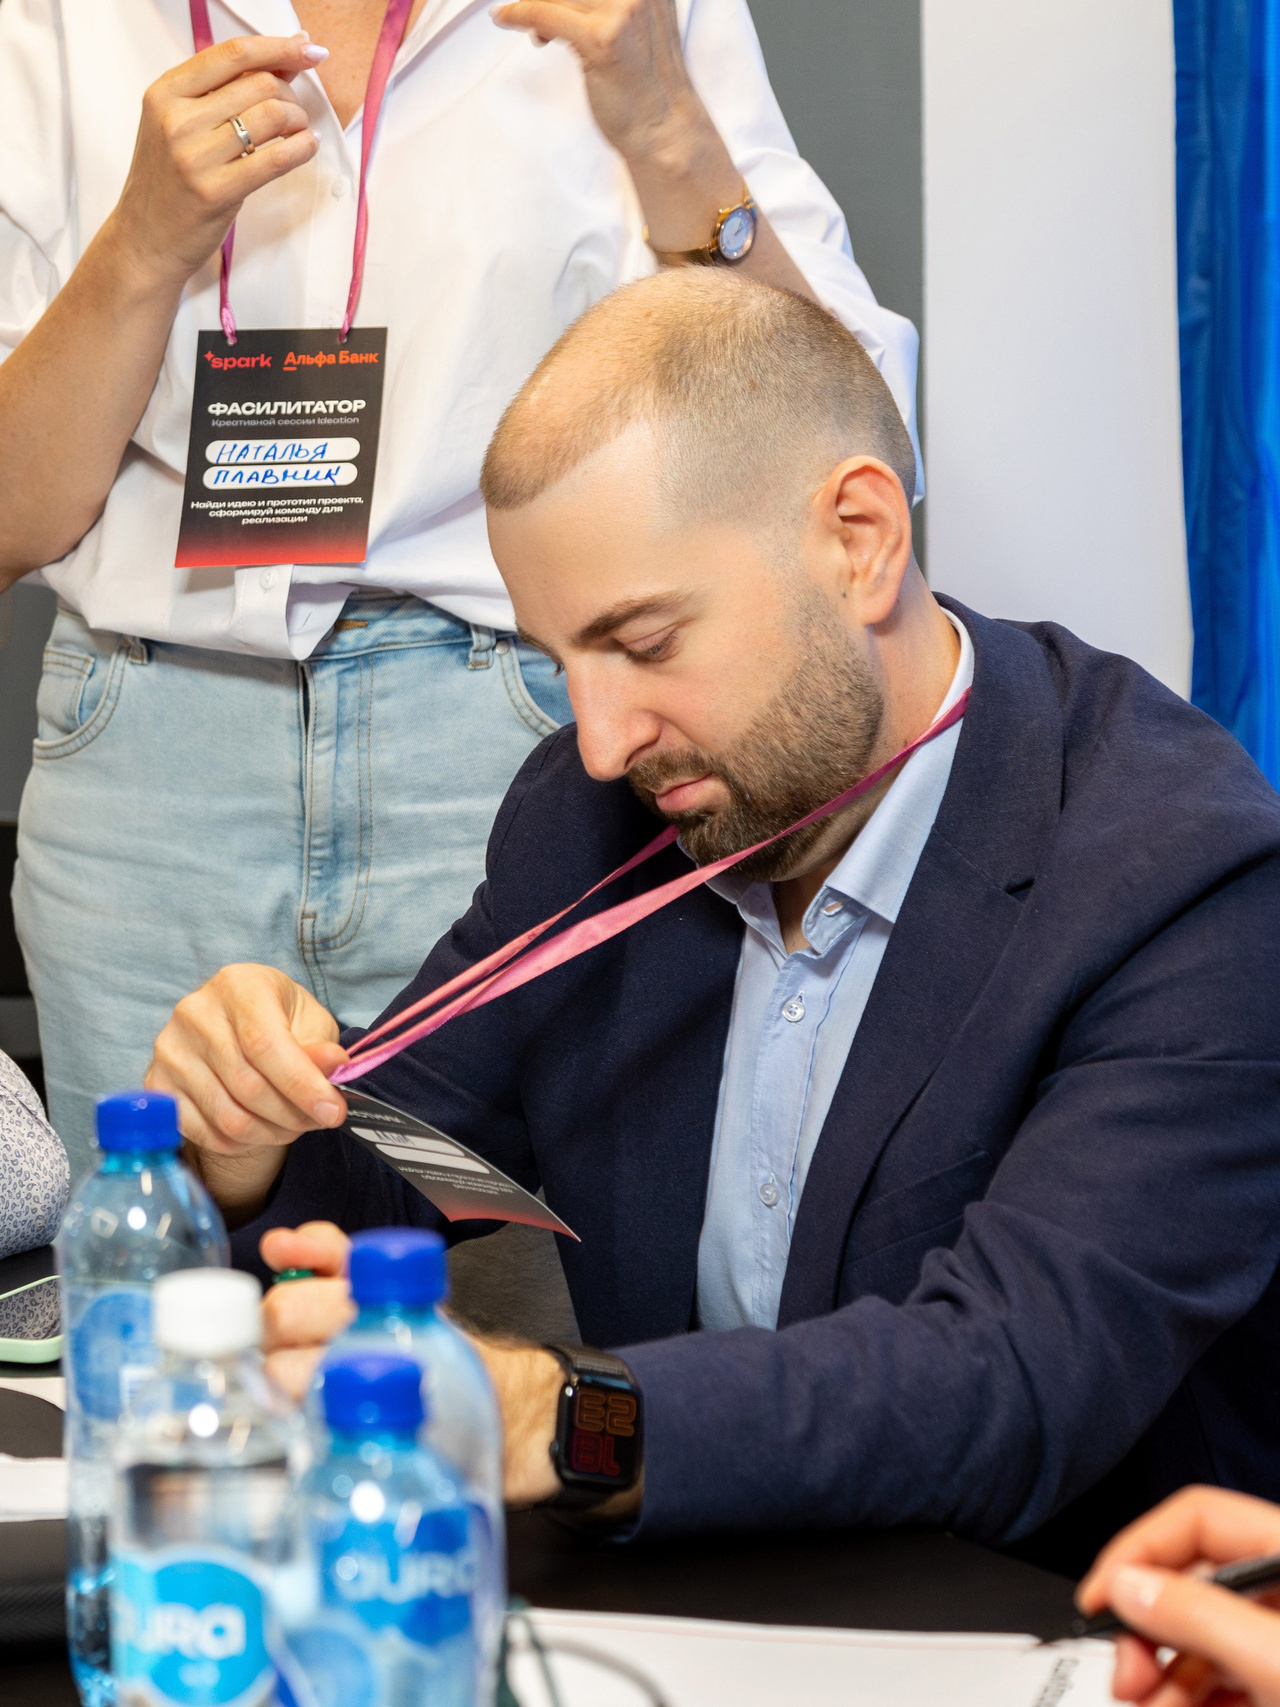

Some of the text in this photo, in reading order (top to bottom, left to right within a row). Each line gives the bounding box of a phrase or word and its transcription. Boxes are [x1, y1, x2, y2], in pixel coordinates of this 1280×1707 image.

[211, 353, 272, 371] spark
[283, 350, 379, 371] Альфа Банк
[207, 400, 366, 416] ФАСИЛИТАТОР
[211, 416, 359, 428] Креативной сессии Ideation
[216, 442, 328, 464] НАТАЛЬЯ
[191, 501, 226, 509] Найди
[227, 500, 256, 509] идею
[266, 498, 317, 508] прототип
[317, 496, 364, 506] проекта,
[209, 505, 343, 518] сформируй команду для
[241, 515, 308, 526] реализации
